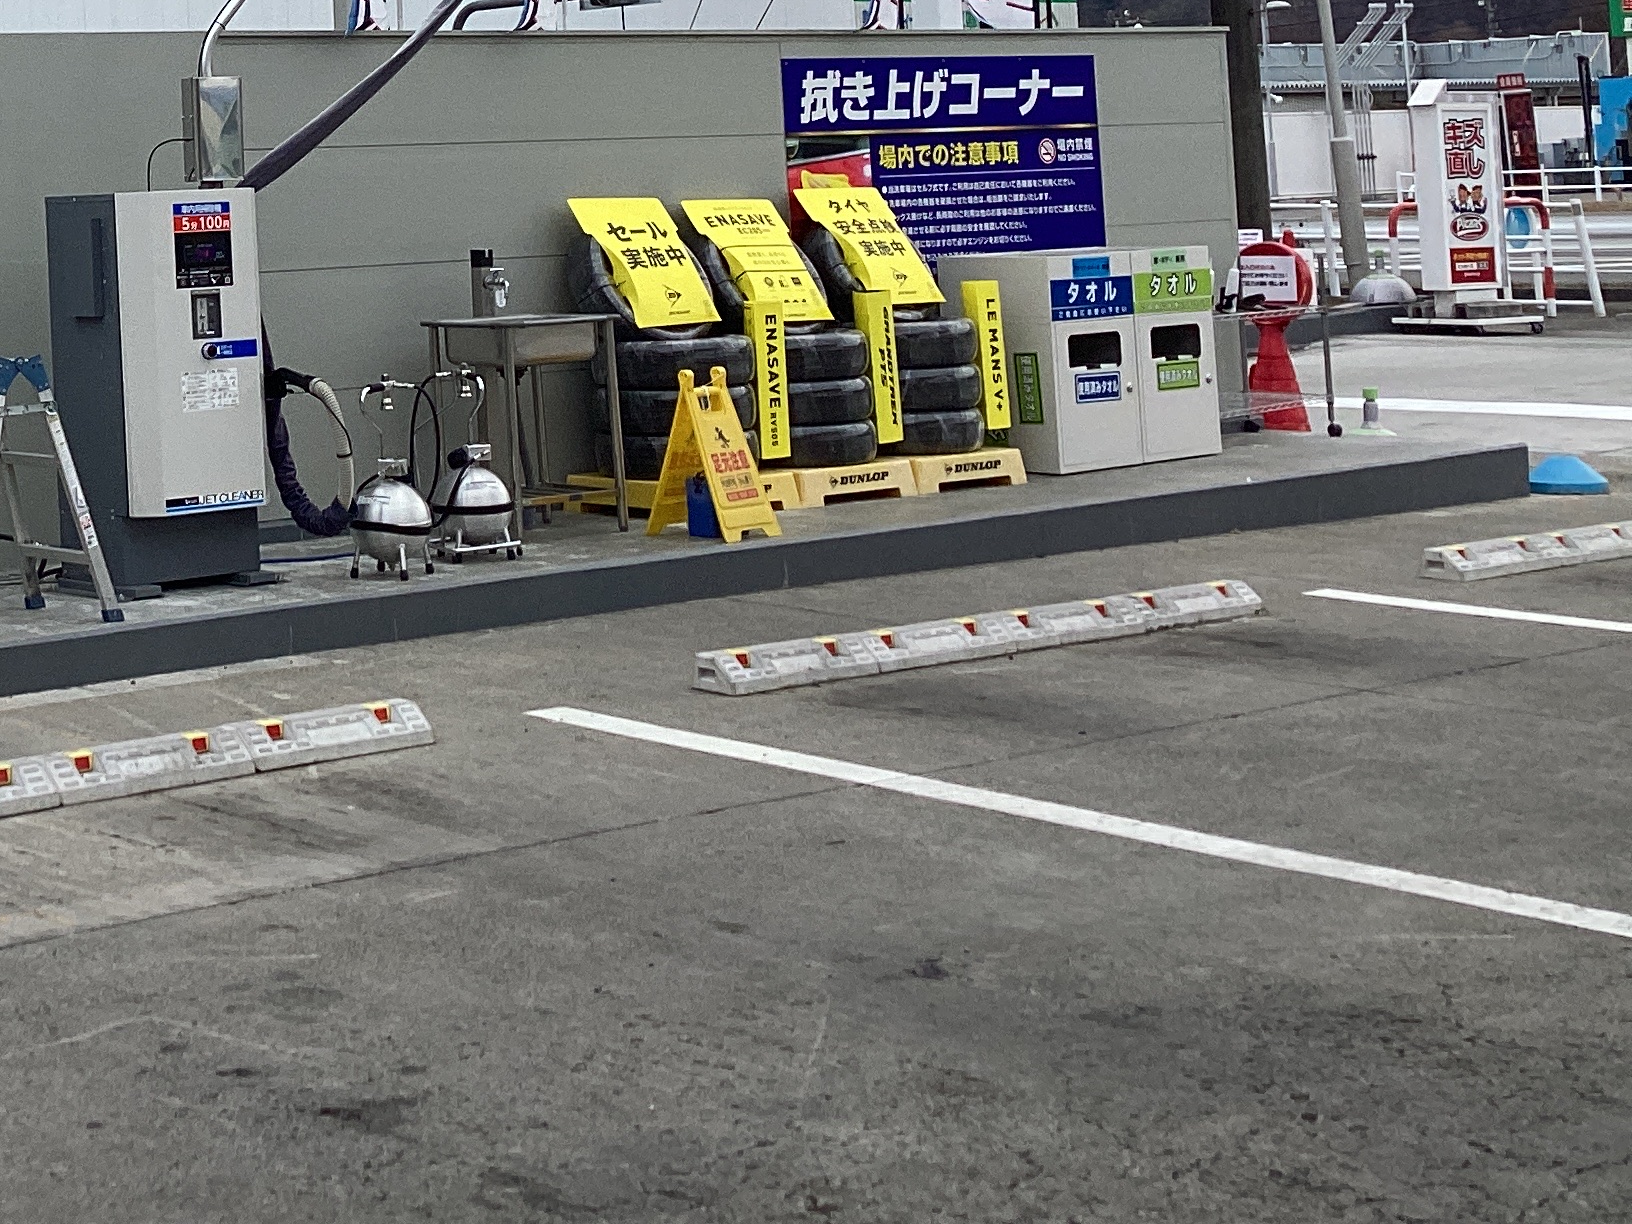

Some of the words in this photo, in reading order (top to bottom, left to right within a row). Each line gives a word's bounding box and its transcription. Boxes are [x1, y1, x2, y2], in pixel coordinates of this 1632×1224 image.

[800, 68, 1084, 124] 拭き上げコーナー
[1443, 118, 1485, 149] キズ
[878, 141, 1019, 169] 場内での注意事項
[1445, 148, 1485, 180] 直し
[828, 198, 871, 214] タイヤ
[607, 221, 668, 243] セール
[703, 213, 777, 228] ENASAVE
[832, 218, 901, 235] 安全点検
[620, 245, 687, 271] 実施中
[858, 238, 907, 257] 実施中
[1067, 281, 1117, 304] タオル
[1150, 272, 1197, 296] タオル
[986, 298, 997, 321] LE
[765, 314, 781, 409] ENASAVE
[988, 328, 1003, 384] MANS
[953, 459, 1001, 474] DUNLOP
[839, 471, 889, 486] DUNLOP
[219, 489, 264, 504] CLEANER
